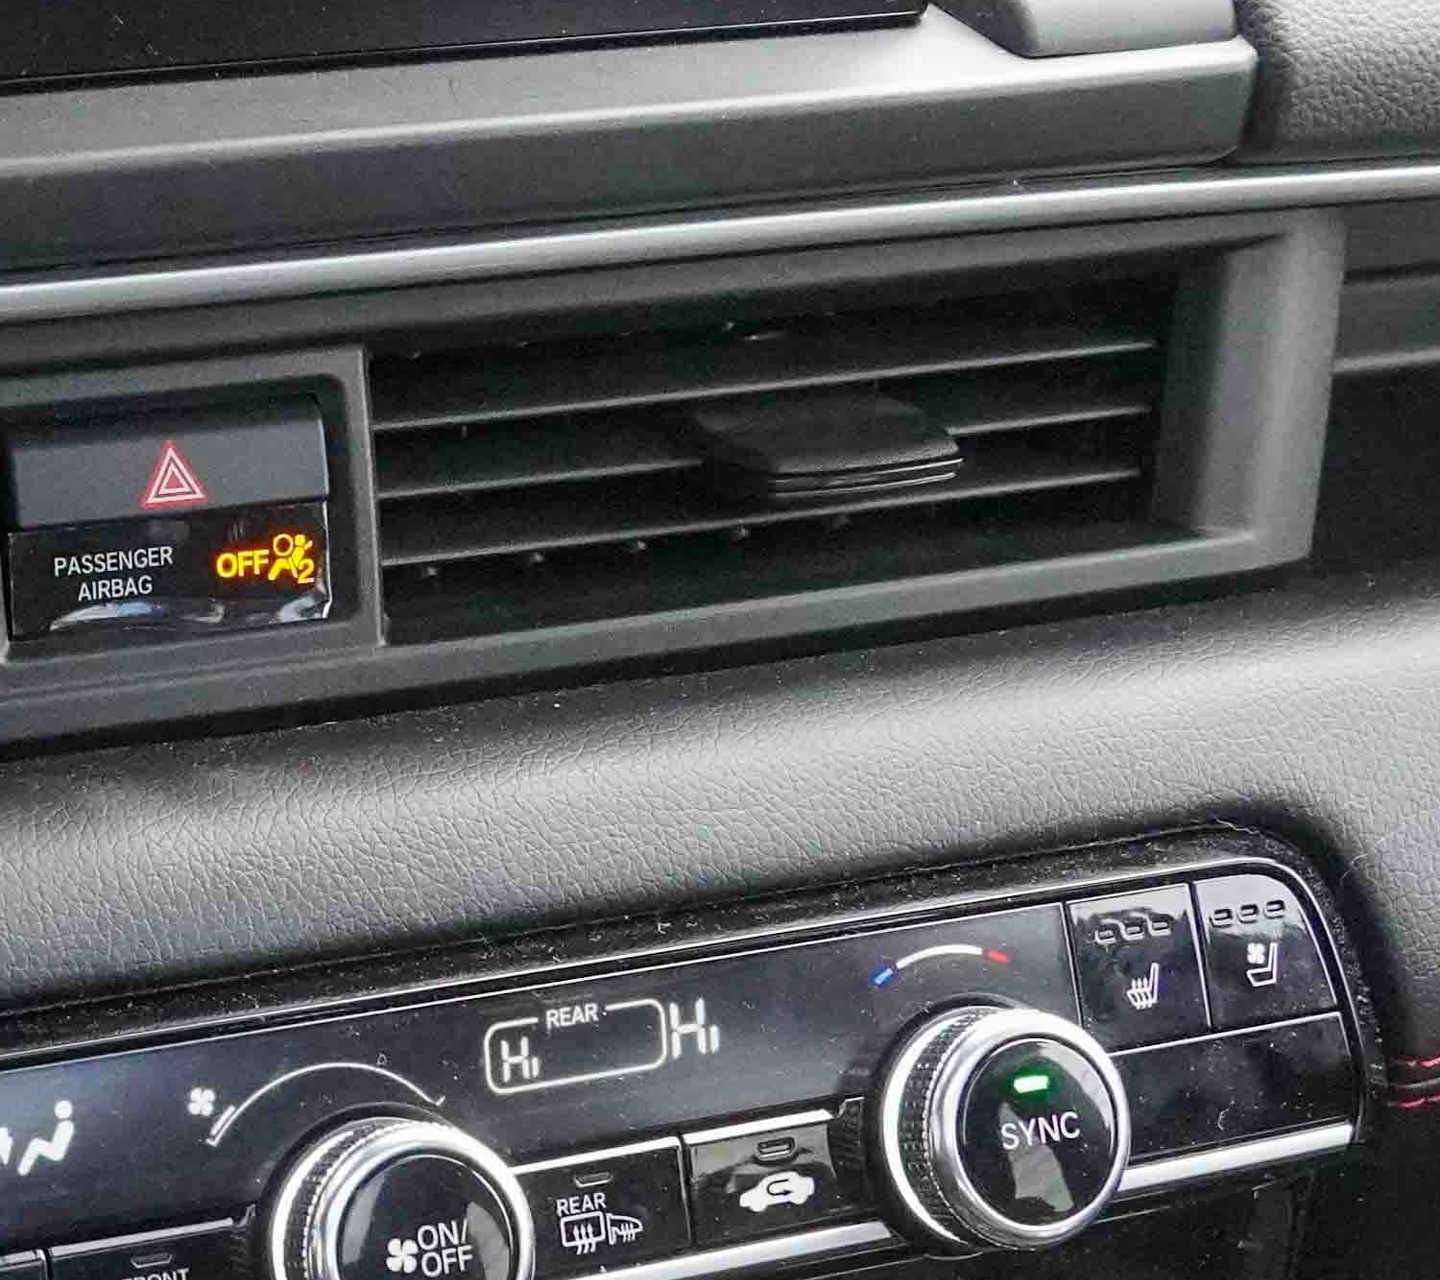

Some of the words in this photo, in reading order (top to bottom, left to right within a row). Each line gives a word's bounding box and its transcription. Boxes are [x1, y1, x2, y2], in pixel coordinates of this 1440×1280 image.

[54, 545, 173, 577] PASSENGER
[217, 549, 269, 578] OFF
[77, 575, 153, 601] AIRBAG
[545, 1003, 599, 1029] REAR
[999, 1110, 1080, 1151] SYNC
[556, 1192, 607, 1216] REAR
[420, 1244, 473, 1279] OFF
